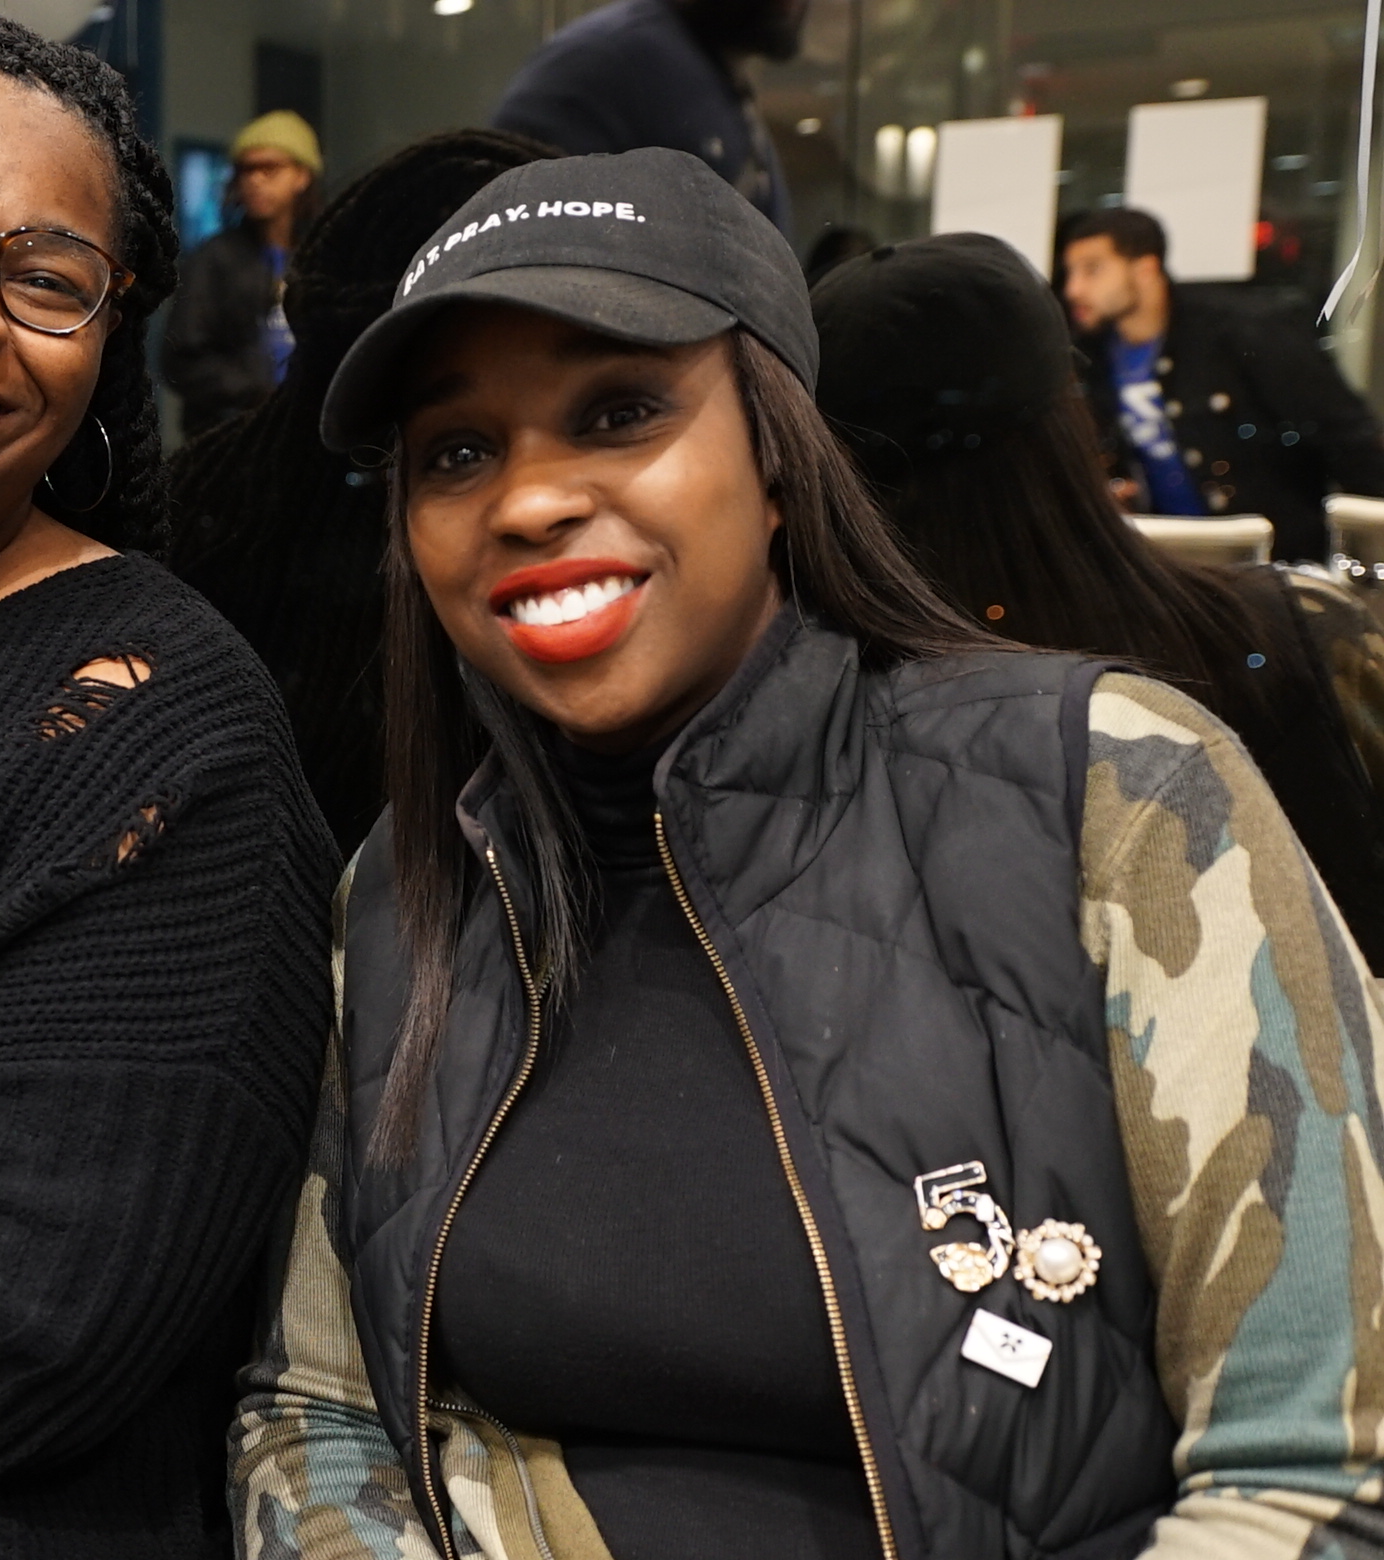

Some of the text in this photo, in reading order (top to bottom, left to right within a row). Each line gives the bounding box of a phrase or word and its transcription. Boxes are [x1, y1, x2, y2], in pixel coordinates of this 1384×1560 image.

[443, 204, 530, 252] PRAY.
[537, 200, 646, 223] HOPE.
[914, 1160, 1015, 1293] 5
